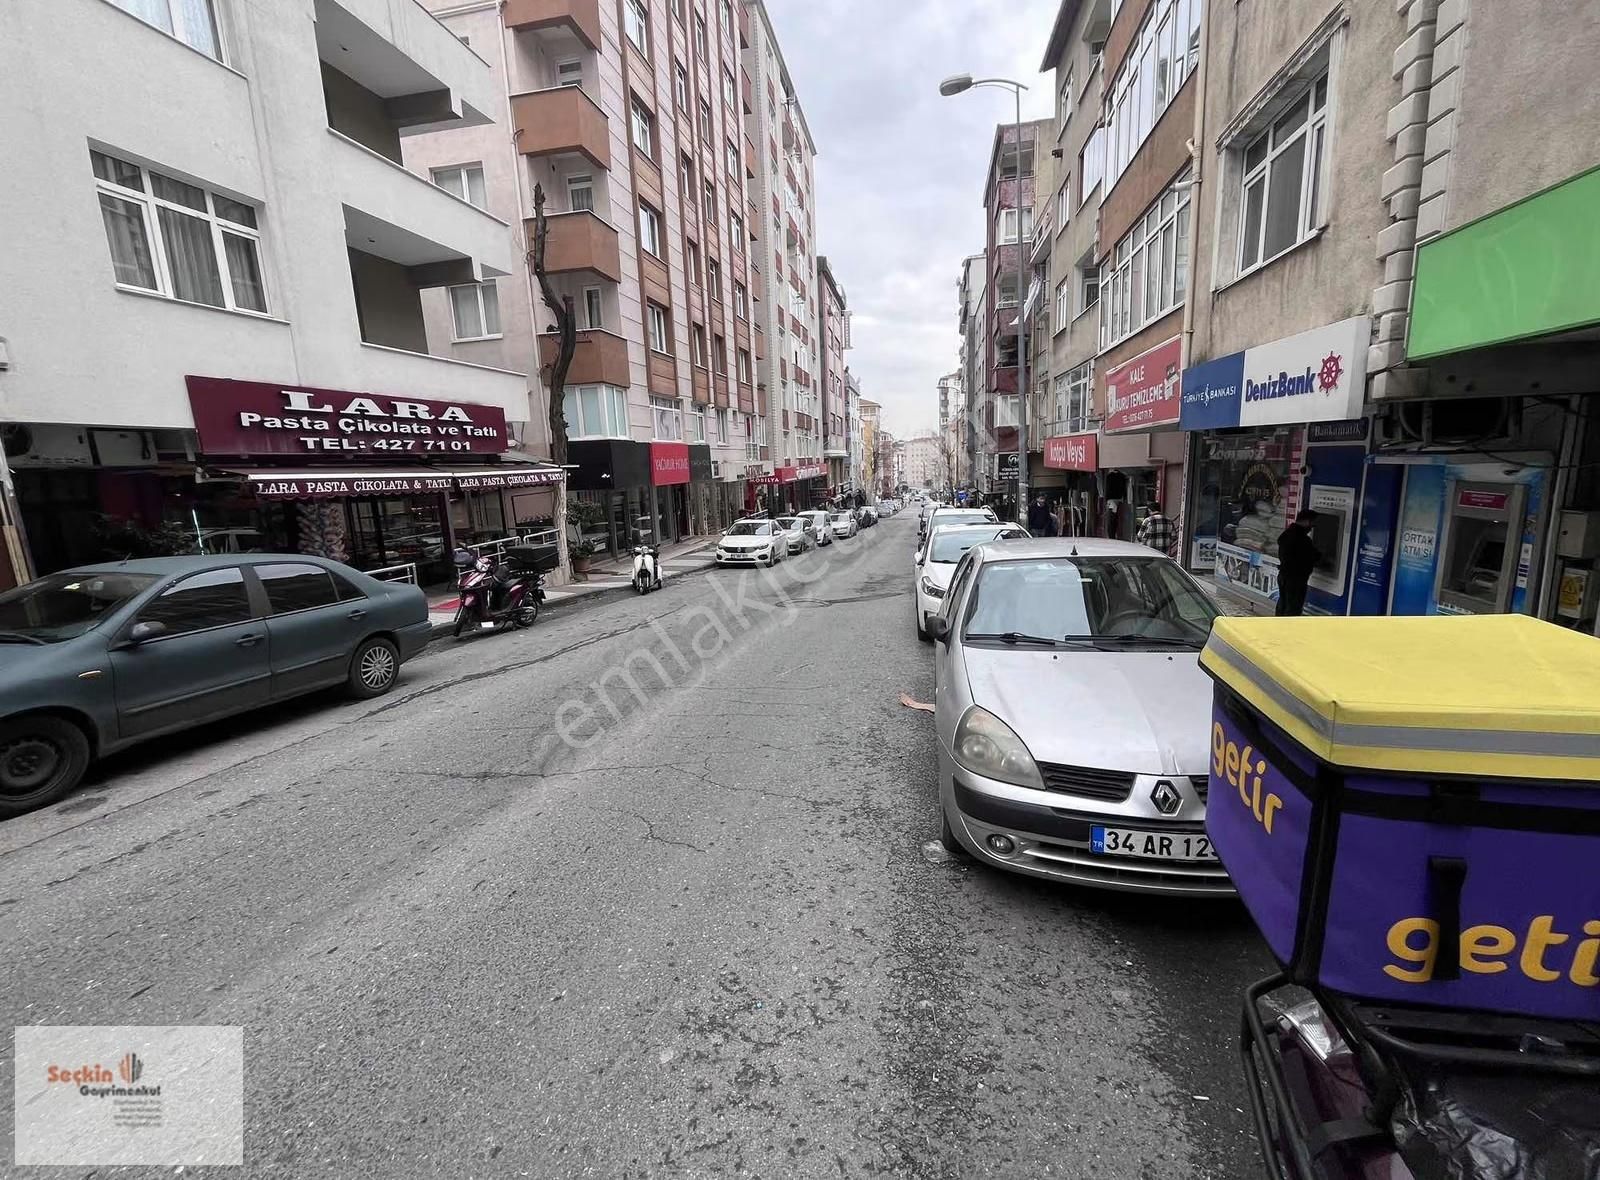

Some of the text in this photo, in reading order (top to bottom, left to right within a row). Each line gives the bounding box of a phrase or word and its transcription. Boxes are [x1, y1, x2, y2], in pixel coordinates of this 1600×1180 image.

[1129, 365, 1145, 385] KALE
[1245, 366, 1317, 402] DenizBank
[1130, 383, 1163, 407] TEMİZLEME
[1209, 385, 1237, 400] BANKASI
[280, 390, 474, 423] LARA
[240, 412, 497, 437] Pasta Çikolata ve Tatlı
[300, 437, 367, 450] TEL:
[373, 439, 416, 450] 427
[1066, 439, 1086, 468] Veysi
[256, 482, 300, 494] LARA
[306, 481, 349, 493] PASTA
[353, 478, 410, 492] ÇİKOLATA
[413, 479, 422, 489] &
[458, 479, 480, 488] LARA
[483, 476, 506, 486] PASTA
[507, 473, 540, 486] ÇİKOLATA
[1403, 532, 1433, 545] ORTAK
[1213, 721, 1283, 835] getir
[1093, 831, 1217, 857] TR 34 AR 12
